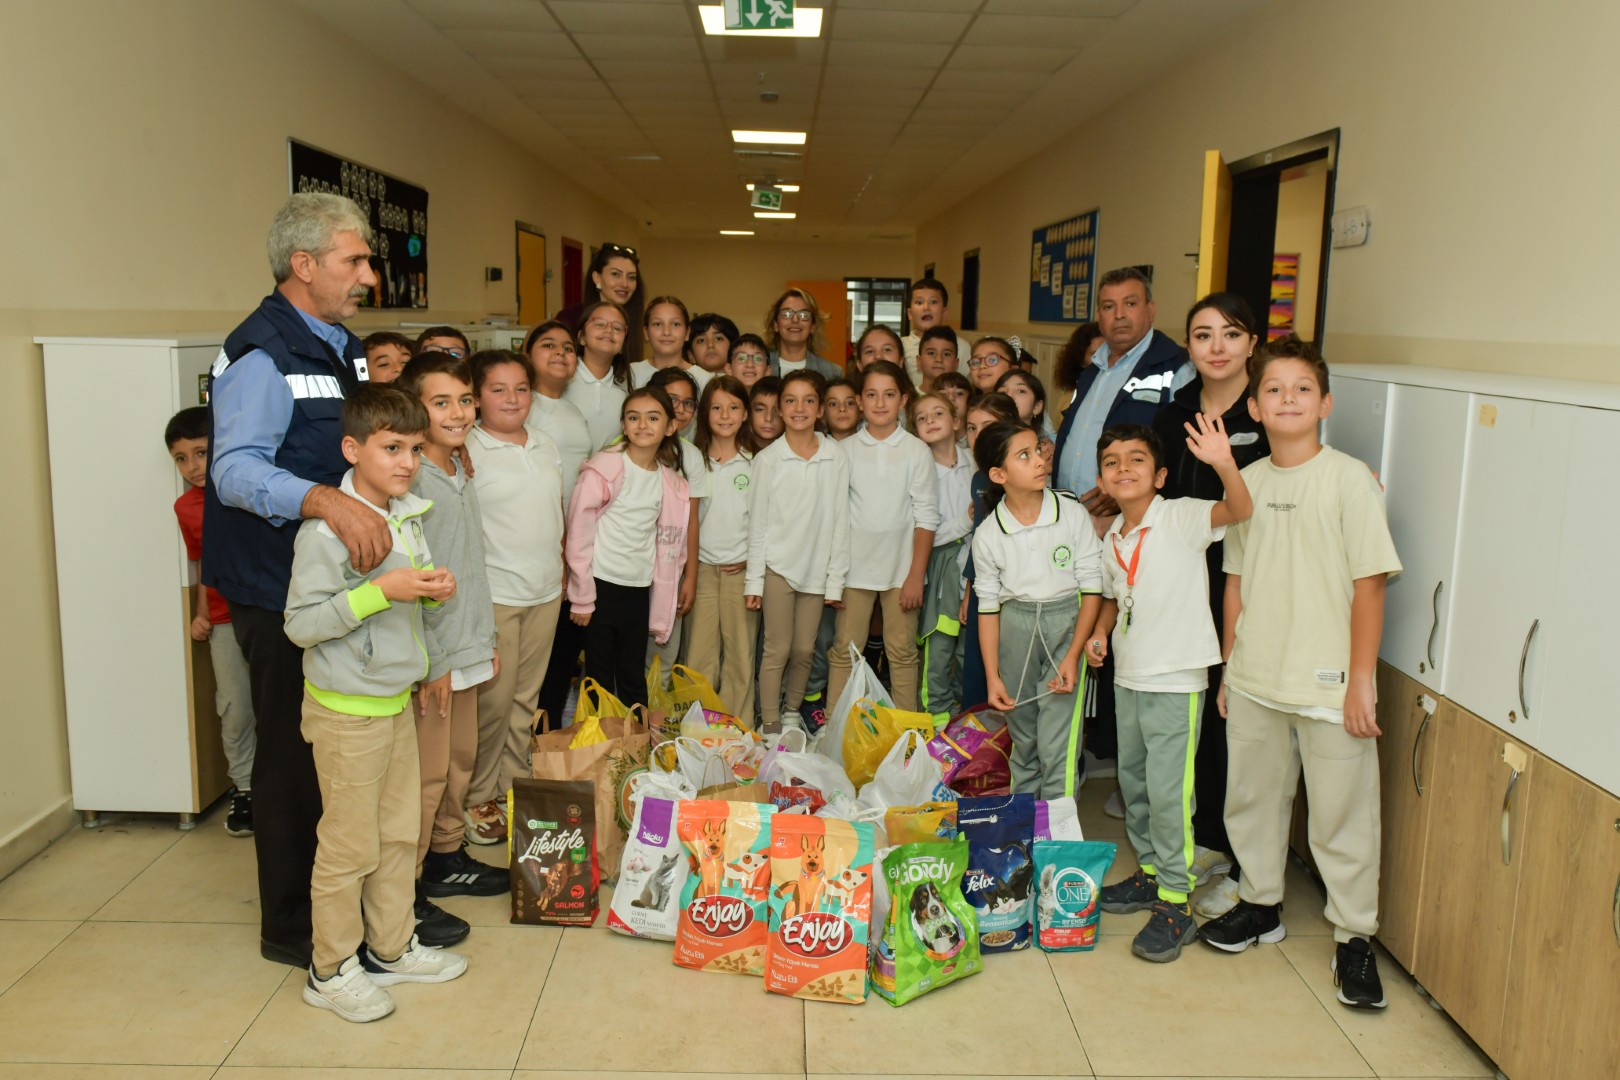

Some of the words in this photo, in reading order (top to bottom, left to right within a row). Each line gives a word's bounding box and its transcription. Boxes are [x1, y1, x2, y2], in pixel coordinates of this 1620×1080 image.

[518, 828, 585, 863] Lifestyle
[901, 857, 955, 885] Goody
[965, 874, 995, 894] felix
[554, 901, 585, 909] SALMON
[1057, 886, 1089, 902] ONE
[692, 898, 746, 932] Enjoy
[783, 916, 845, 952] Enjoy
